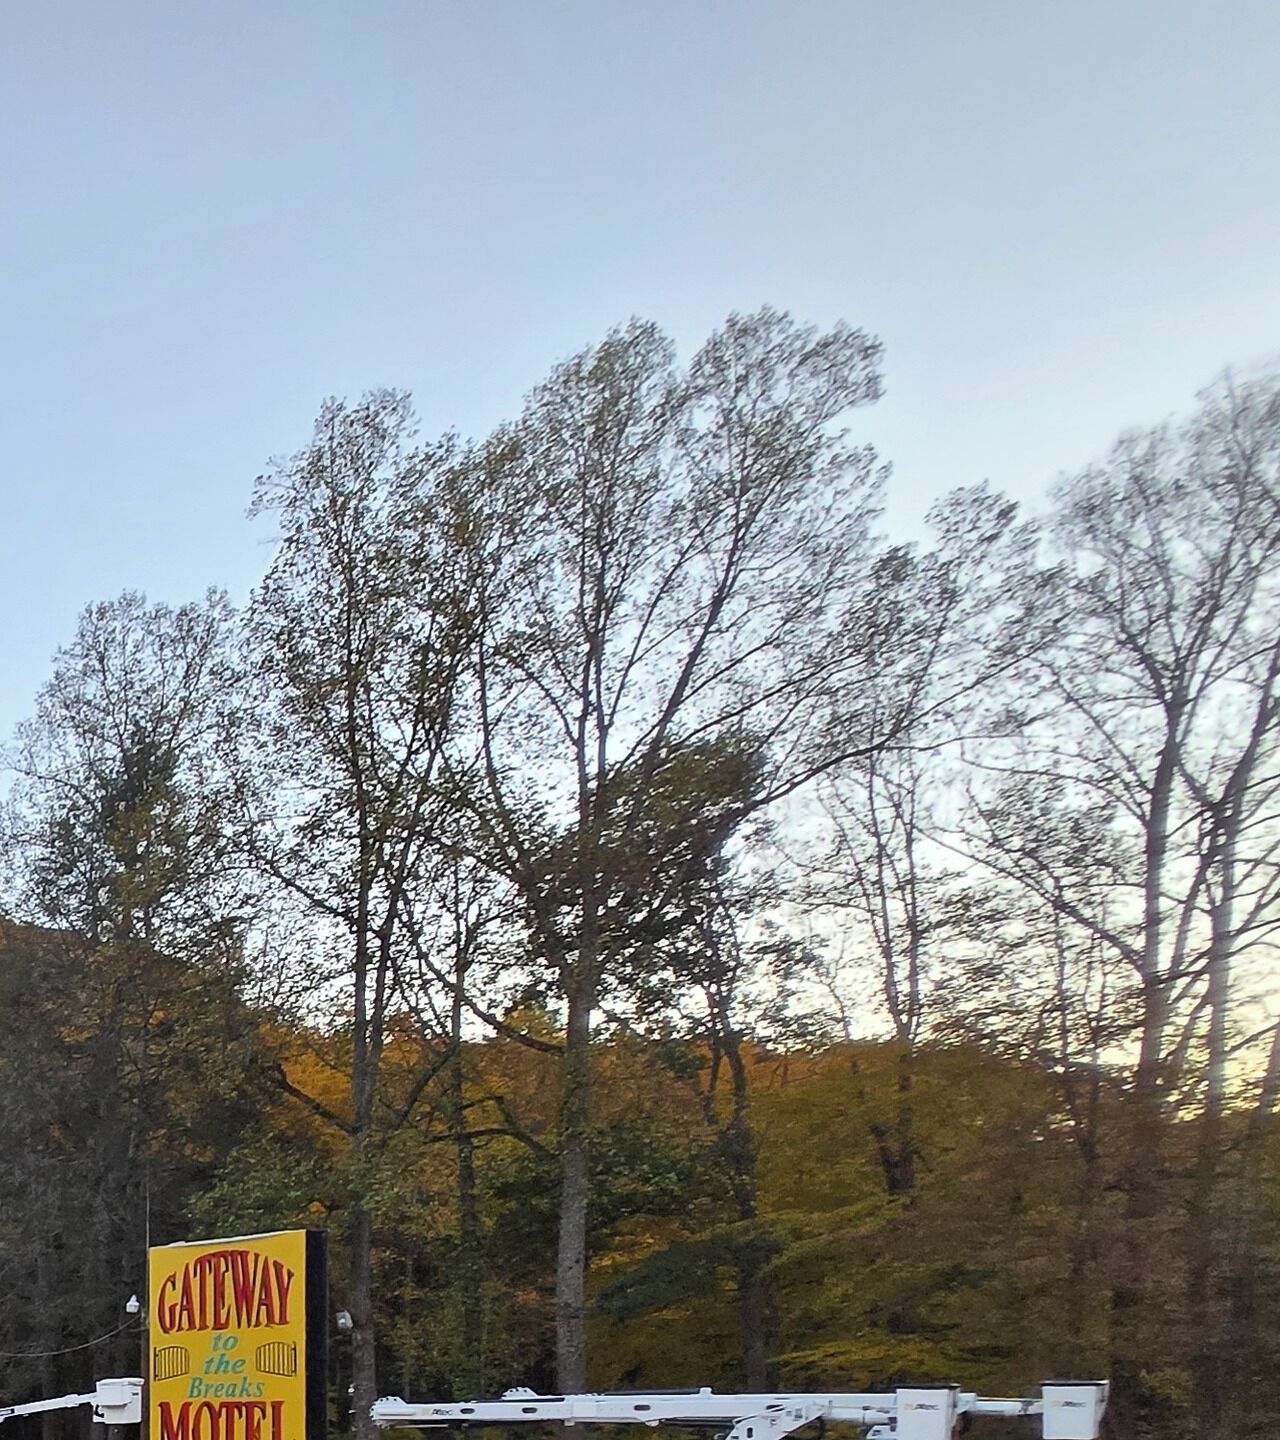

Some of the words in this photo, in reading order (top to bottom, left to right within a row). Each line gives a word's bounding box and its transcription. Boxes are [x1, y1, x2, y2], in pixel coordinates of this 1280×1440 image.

[157, 1249, 296, 1335] GATEWAY
[211, 1332, 239, 1351] to
[203, 1353, 247, 1375] the
[187, 1376, 265, 1399] Breaks
